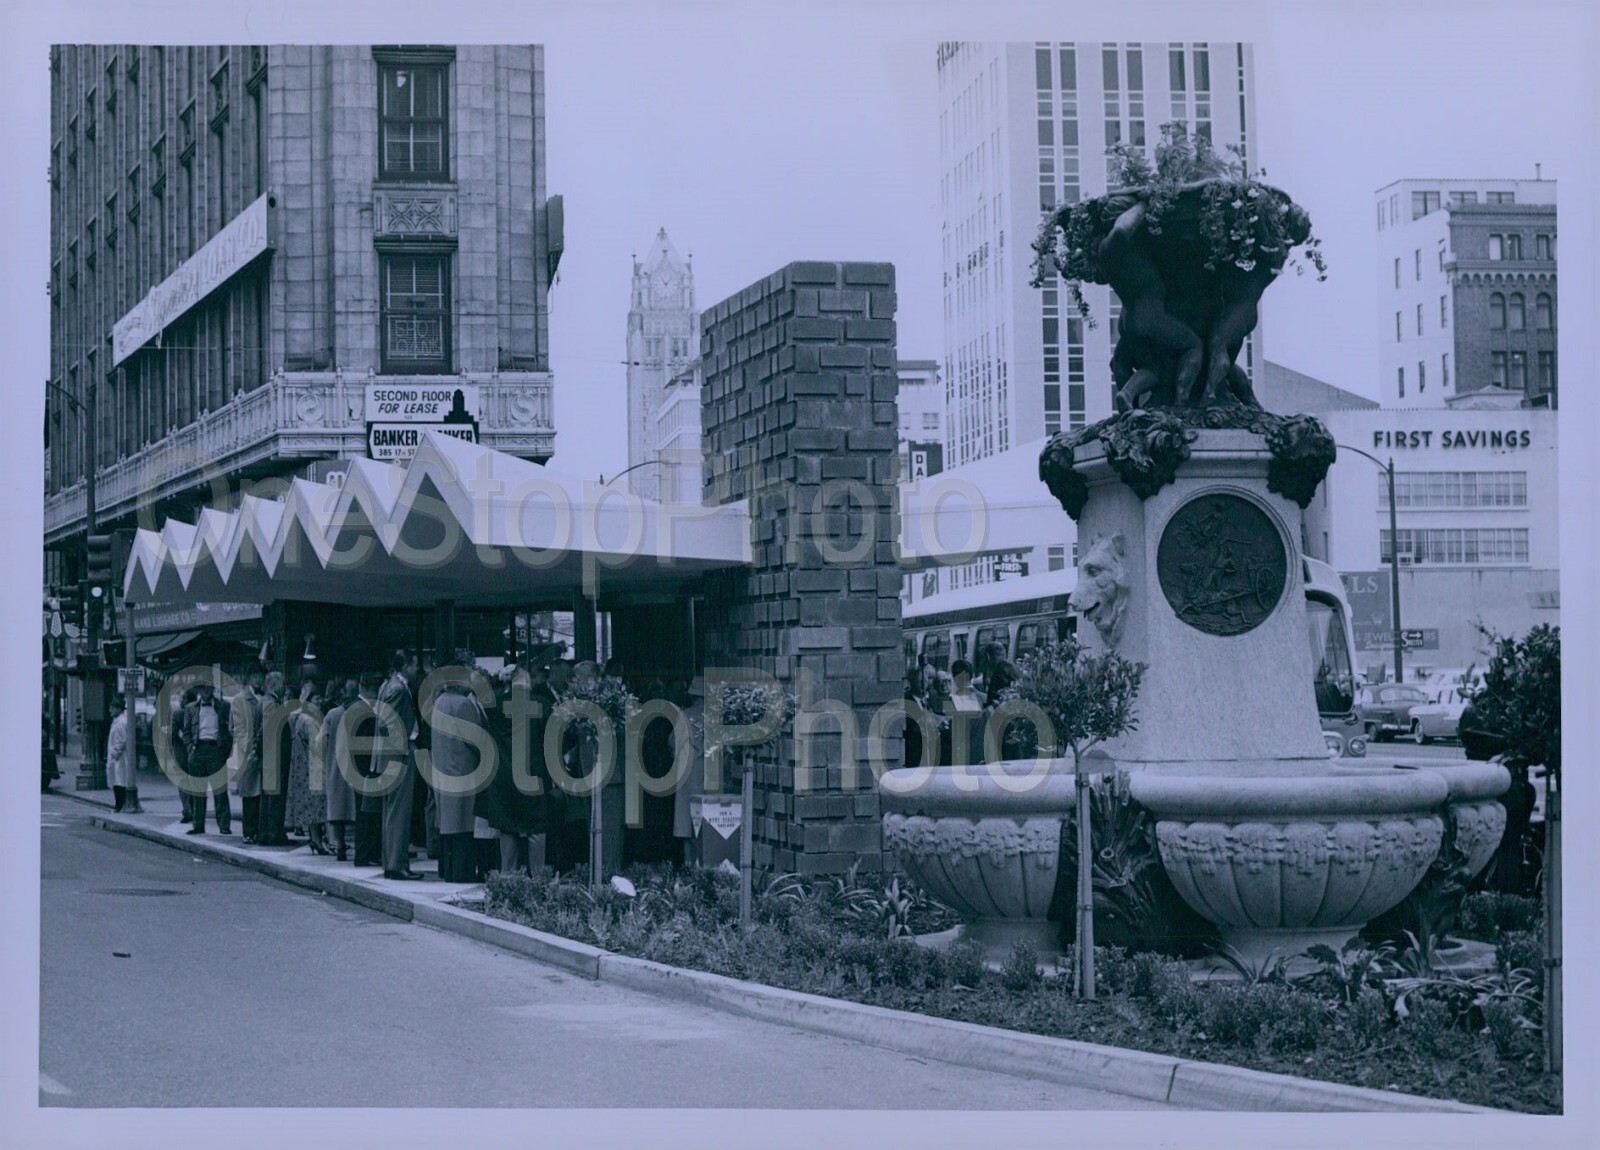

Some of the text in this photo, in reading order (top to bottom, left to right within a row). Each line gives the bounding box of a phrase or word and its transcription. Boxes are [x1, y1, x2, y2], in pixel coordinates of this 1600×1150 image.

[373, 390, 452, 402] SECOND FLOOR
[377, 403, 439, 414] FOR LEASE
[373, 429, 418, 446] BANKER
[1373, 430, 1531, 448] FIRST SAVINGS
[378, 448, 392, 456] 385
